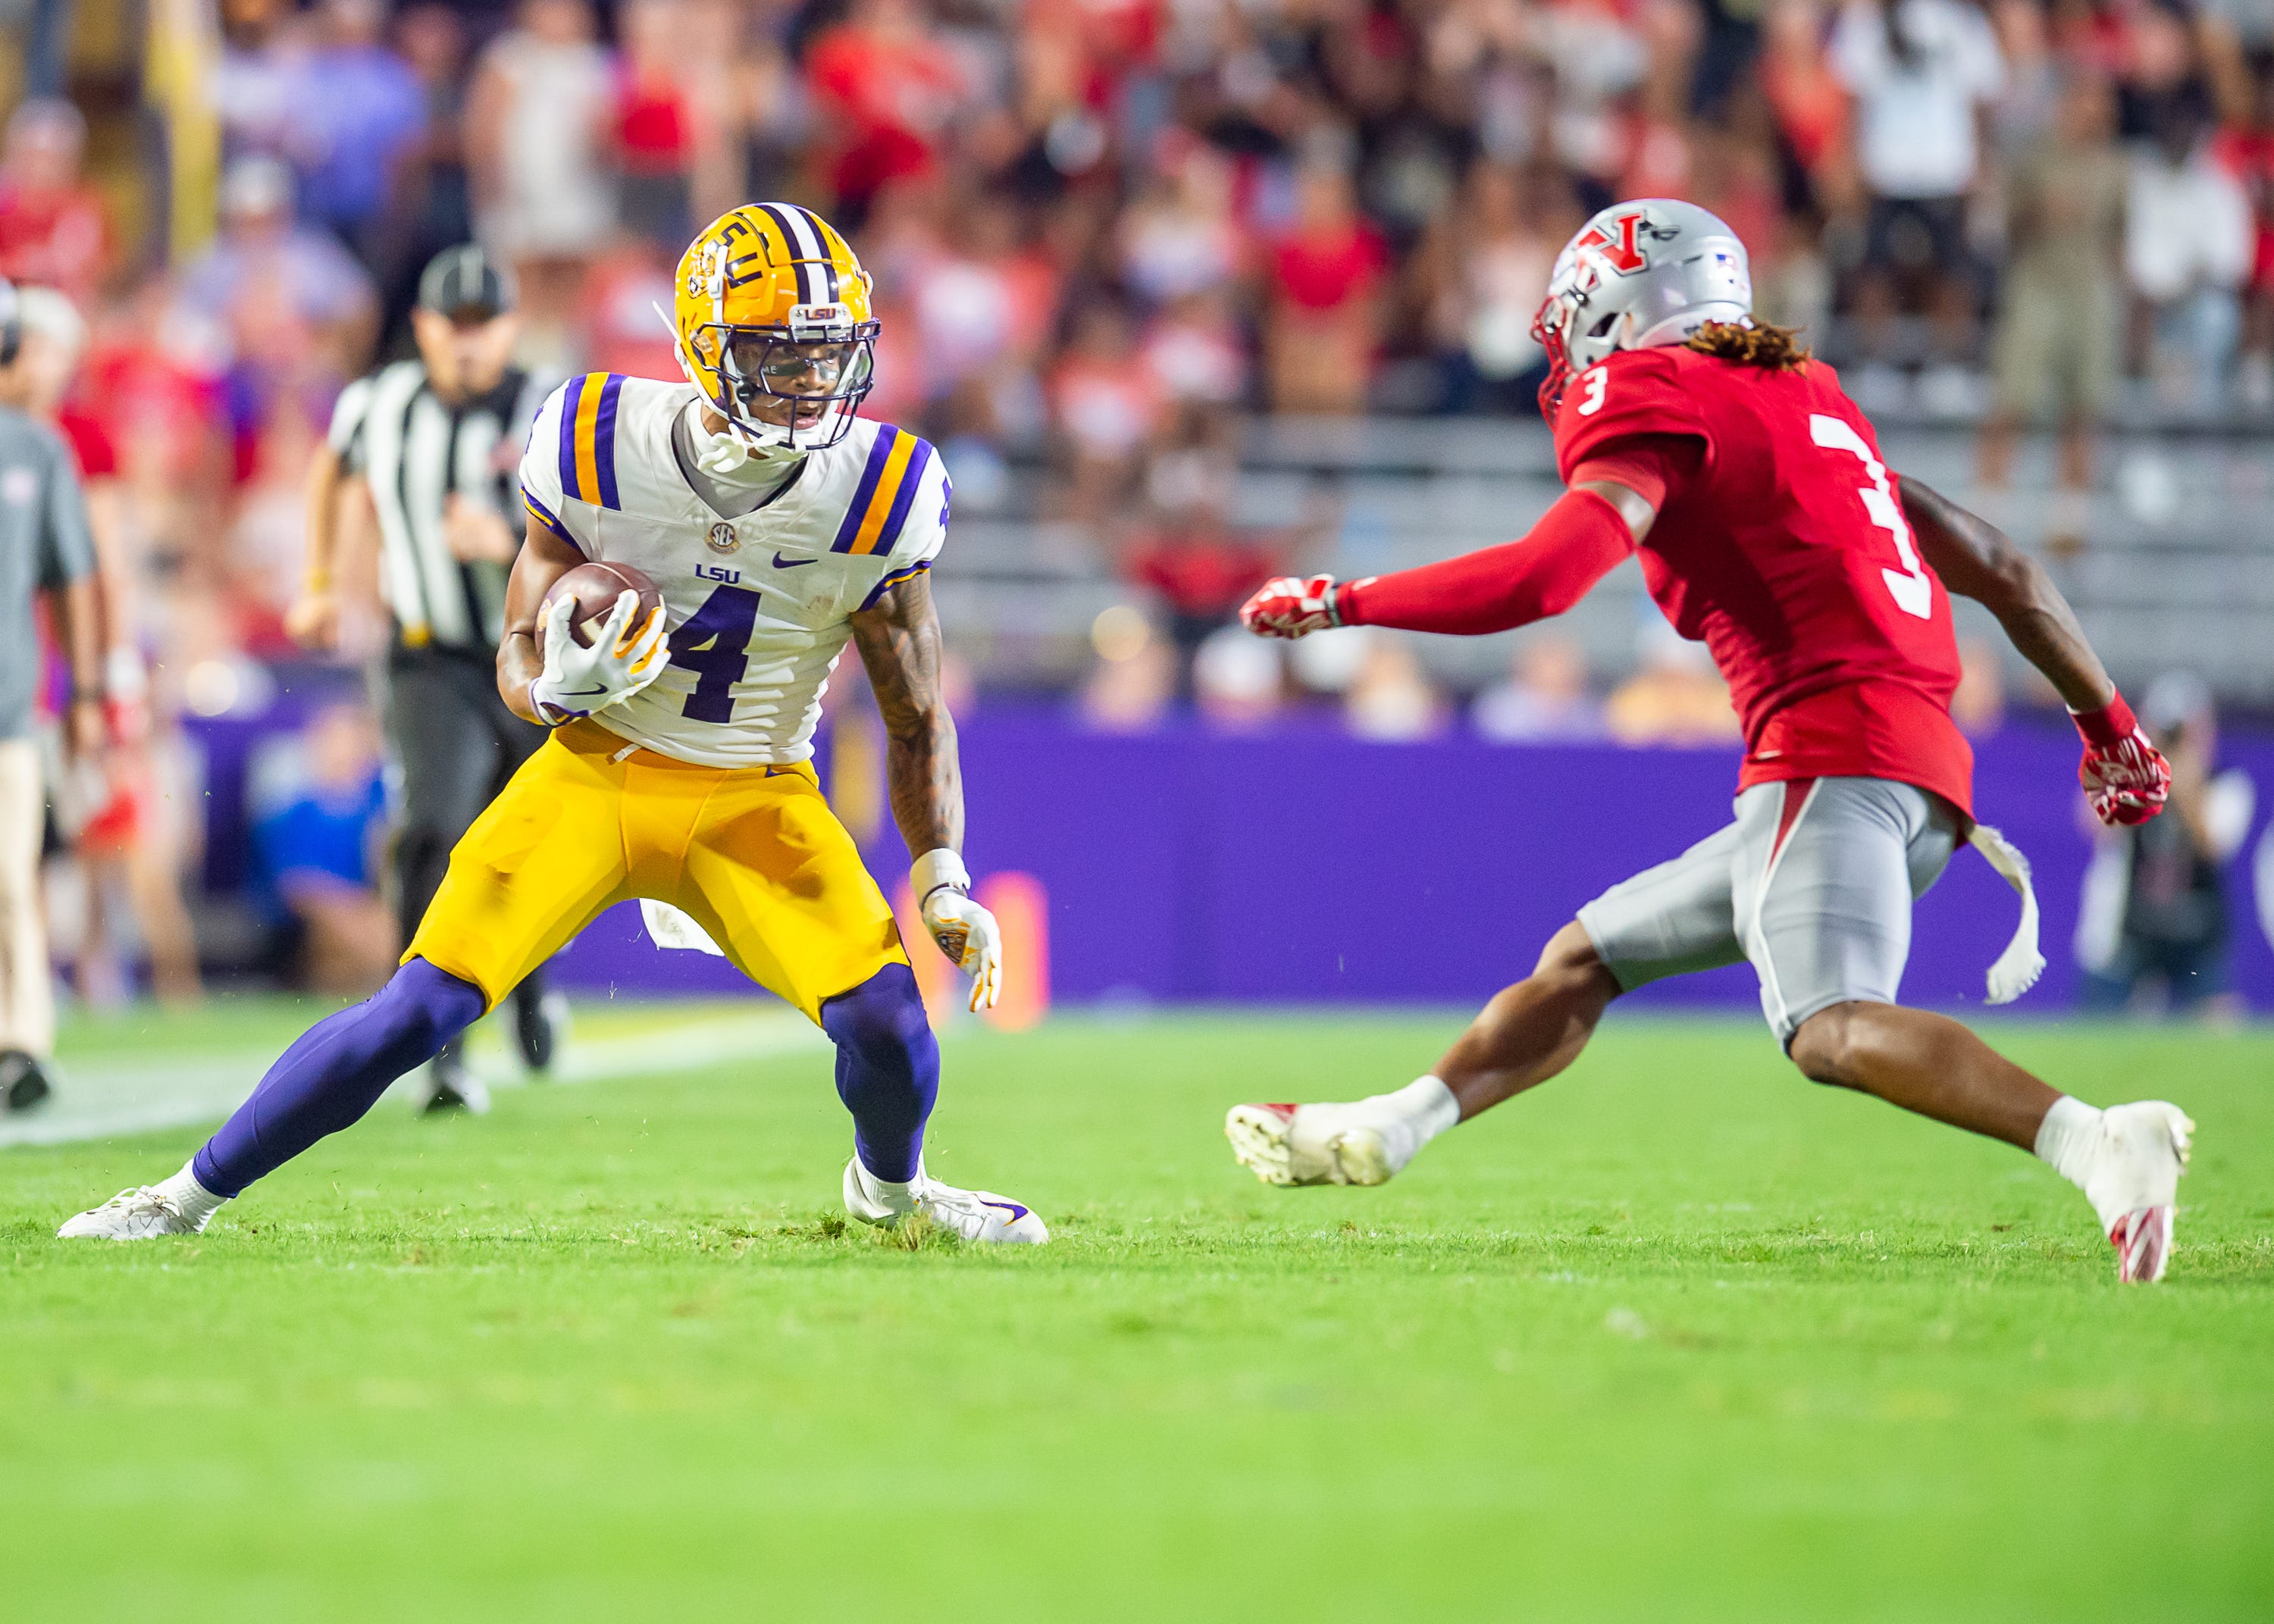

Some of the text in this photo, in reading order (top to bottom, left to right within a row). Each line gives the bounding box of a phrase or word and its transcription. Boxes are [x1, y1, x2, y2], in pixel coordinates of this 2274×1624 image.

[805, 308, 836, 321] LSU
[1577, 366, 1608, 416] 3
[1809, 413, 1932, 620] 3
[712, 524, 735, 546] SEC
[695, 563, 741, 584] LSU
[667, 584, 762, 724] 4
